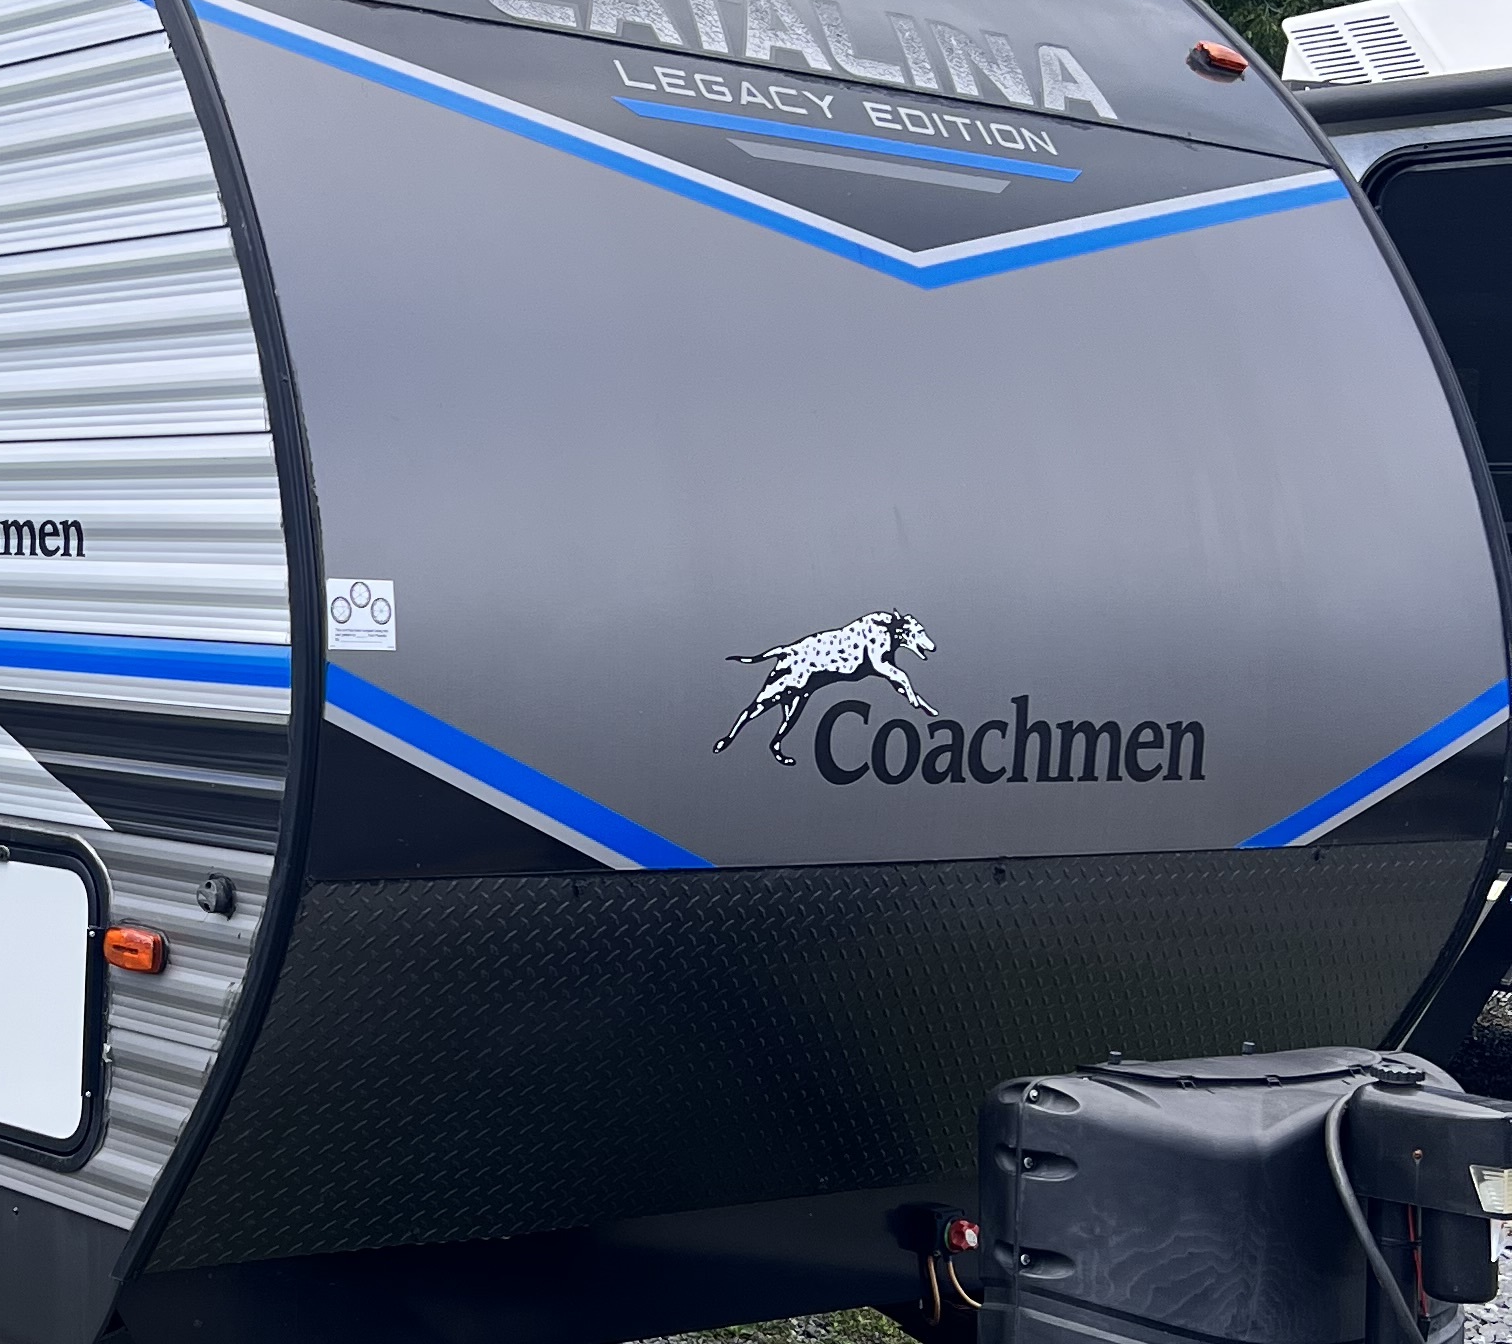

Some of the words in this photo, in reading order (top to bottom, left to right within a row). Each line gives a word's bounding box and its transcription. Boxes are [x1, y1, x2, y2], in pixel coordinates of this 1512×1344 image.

[613, 60, 835, 119] LEGACY
[862, 101, 1059, 155] EDITION
[814, 695, 1206, 787] Coachmen
